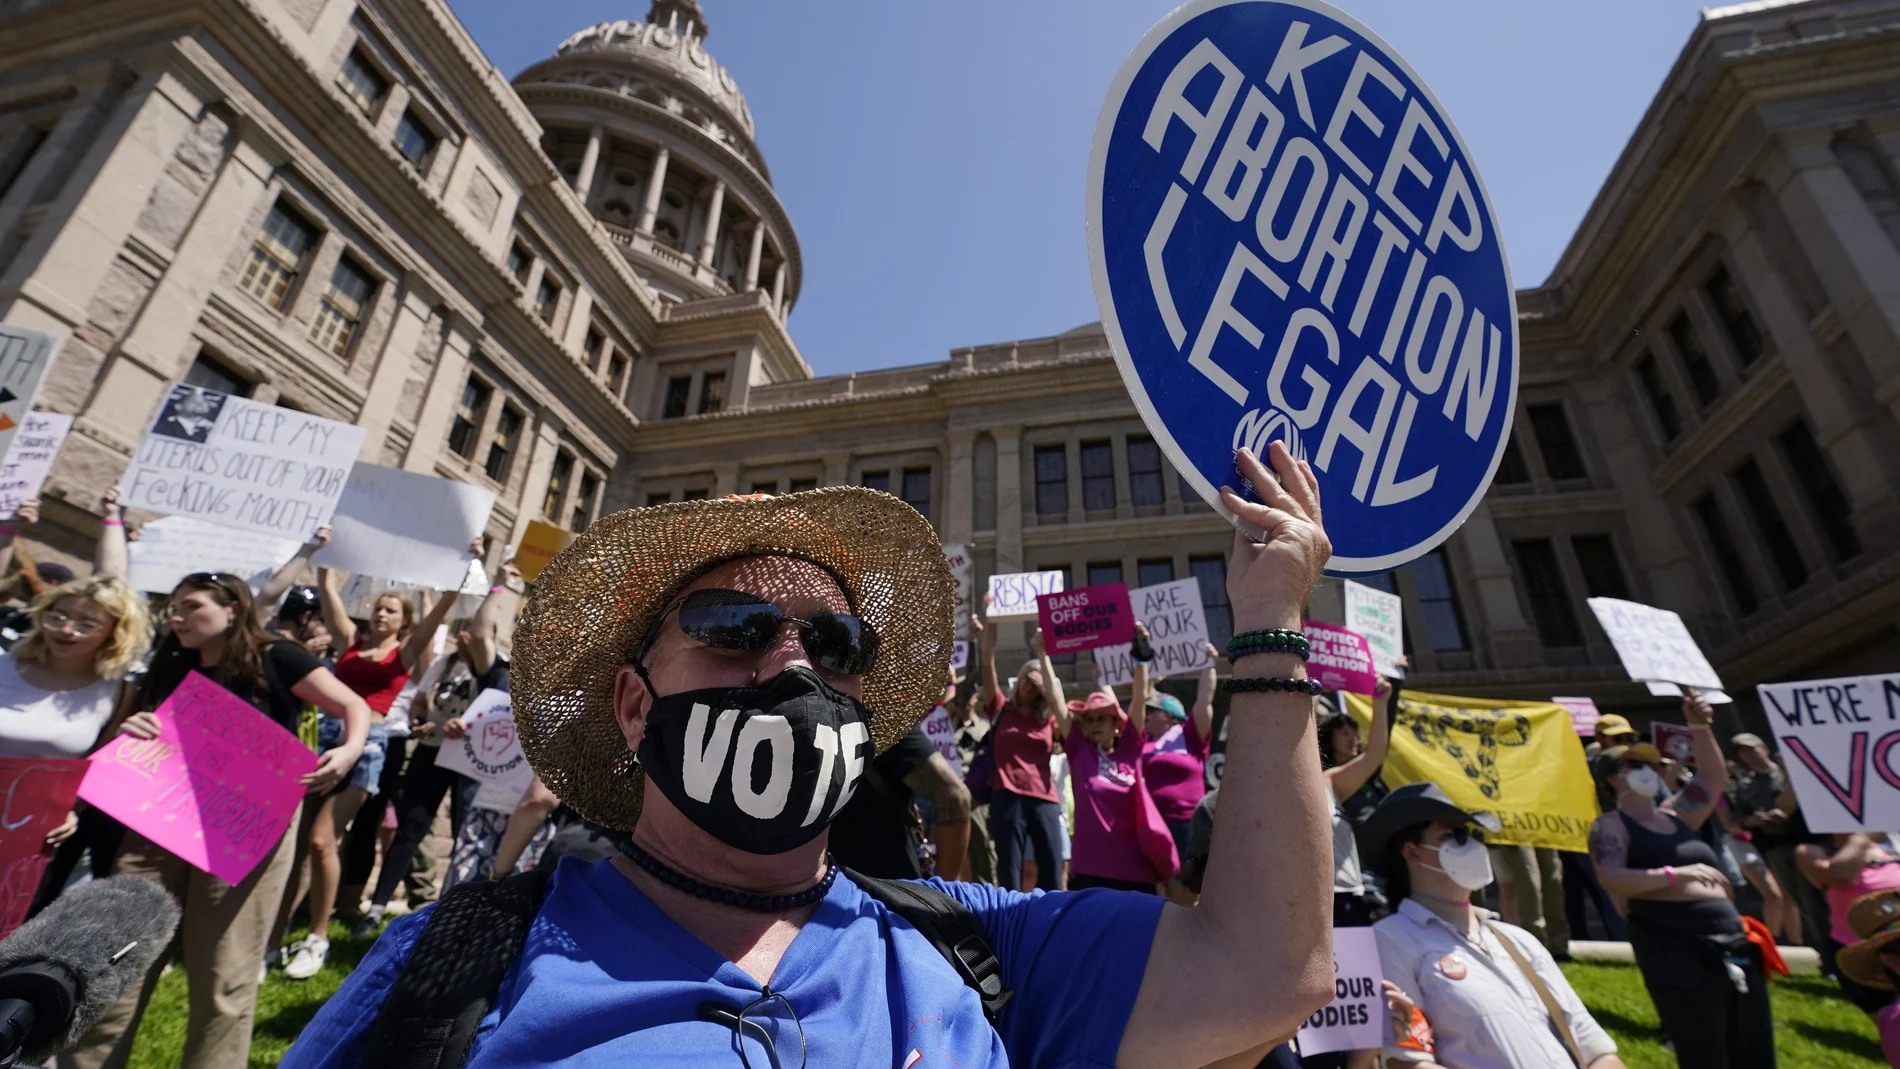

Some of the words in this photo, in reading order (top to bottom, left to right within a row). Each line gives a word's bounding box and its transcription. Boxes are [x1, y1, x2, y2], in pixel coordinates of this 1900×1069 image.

[1265, 20, 1482, 253] KEEP
[1142, 37, 1501, 442] ABORTION
[1143, 181, 1439, 507] LEGAL
[221, 403, 286, 444] KEEP
[288, 420, 337, 456] MY
[136, 437, 223, 476] UTERUS
[223, 451, 273, 484] OUT
[267, 458, 296, 489] OF
[301, 462, 346, 498] YOUR
[235, 491, 325, 535] MOUTH
[994, 574, 1056, 608] RESIST!
[1048, 593, 1089, 610] BANS
[1144, 586, 1185, 615] ARE
[1051, 608, 1080, 624] OFF
[1083, 603, 1117, 617] OUR
[1054, 617, 1112, 637] BODIES
[1139, 609, 1198, 642] YOUR
[1303, 625, 1360, 648] PROTECT
[1310, 641, 1330, 655] FE,
[1332, 642, 1371, 664] LEGAL
[1101, 638, 1211, 684] HAMAIDS
[1307, 652, 1369, 674] BORTION
[177, 681, 291, 770] FREEDOM
[1764, 683, 1872, 727] WE'RE
[463, 734, 524, 775] ROEVOLUTION
[683, 702, 870, 828] VOTE
[114, 737, 177, 774] OUR
[154, 770, 278, 858] FREEDOM
[1496, 810, 1543, 832] EAD
[1545, 816, 1575, 834] ON
[1335, 977, 1376, 999] OUR
